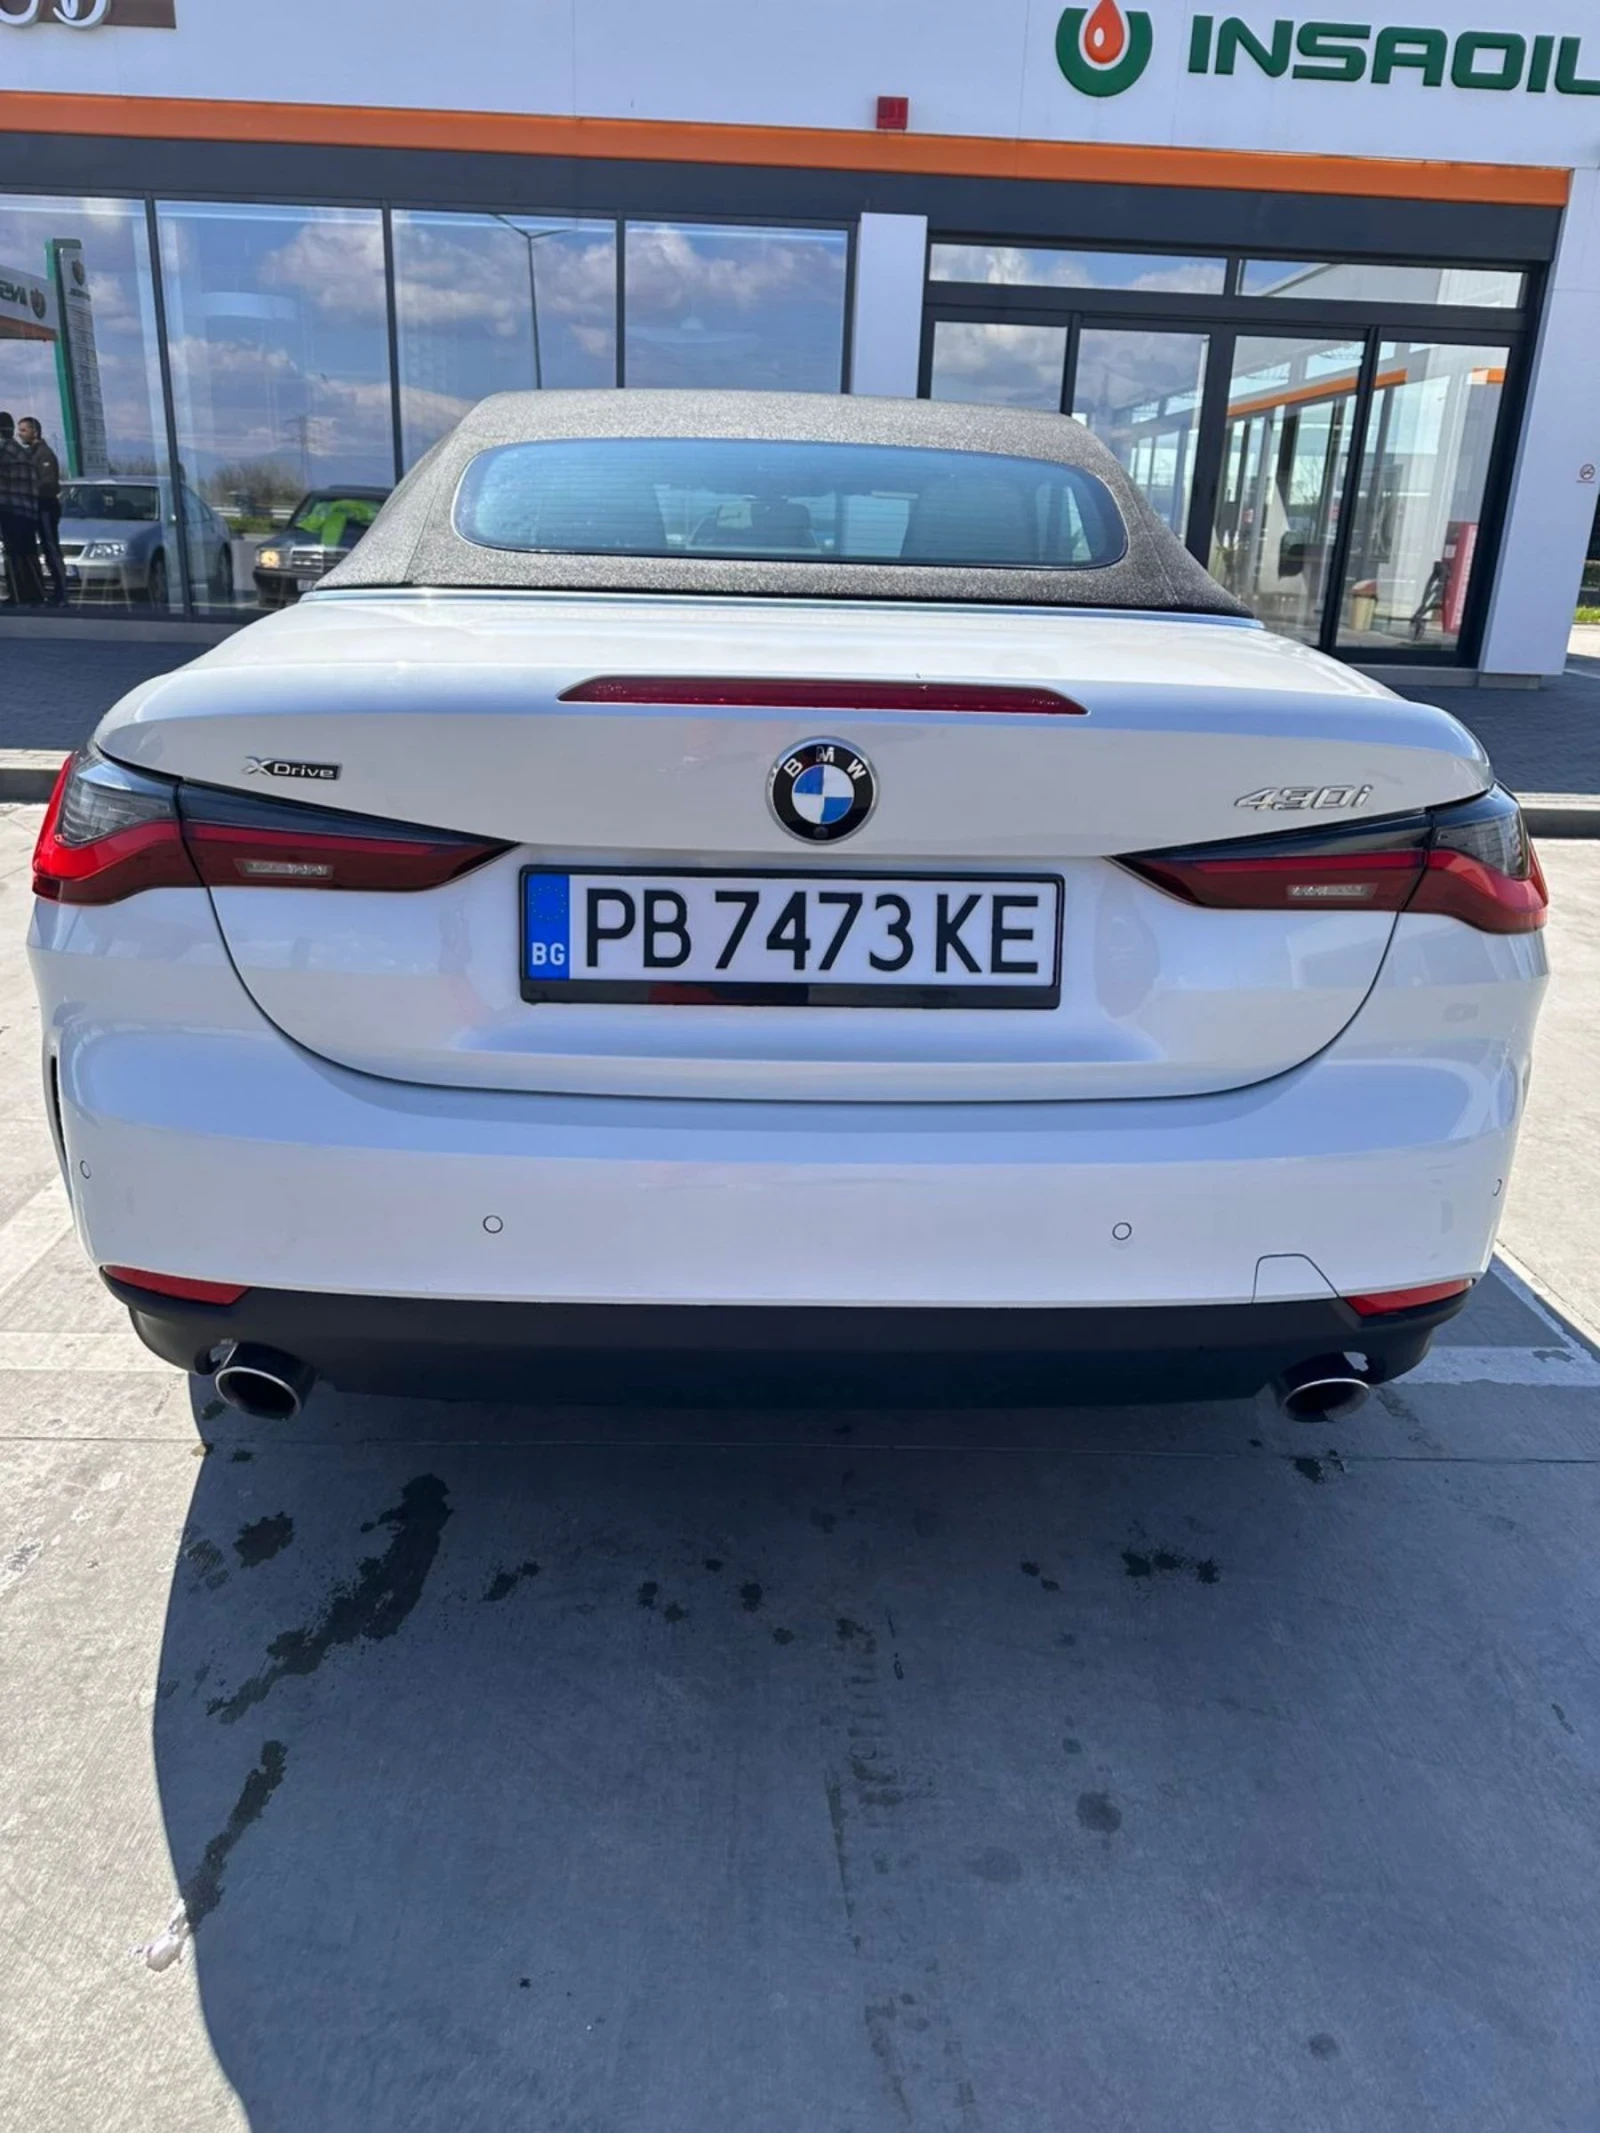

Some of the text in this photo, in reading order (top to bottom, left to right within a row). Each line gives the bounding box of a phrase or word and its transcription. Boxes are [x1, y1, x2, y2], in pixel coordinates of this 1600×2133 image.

[1188, 15, 1600, 96] INSAOIL
[783, 746, 867, 781] BMW
[1234, 784, 1374, 810] 430i
[586, 888, 1039, 974] PB 7473 KE
[531, 942, 565, 966] BG
